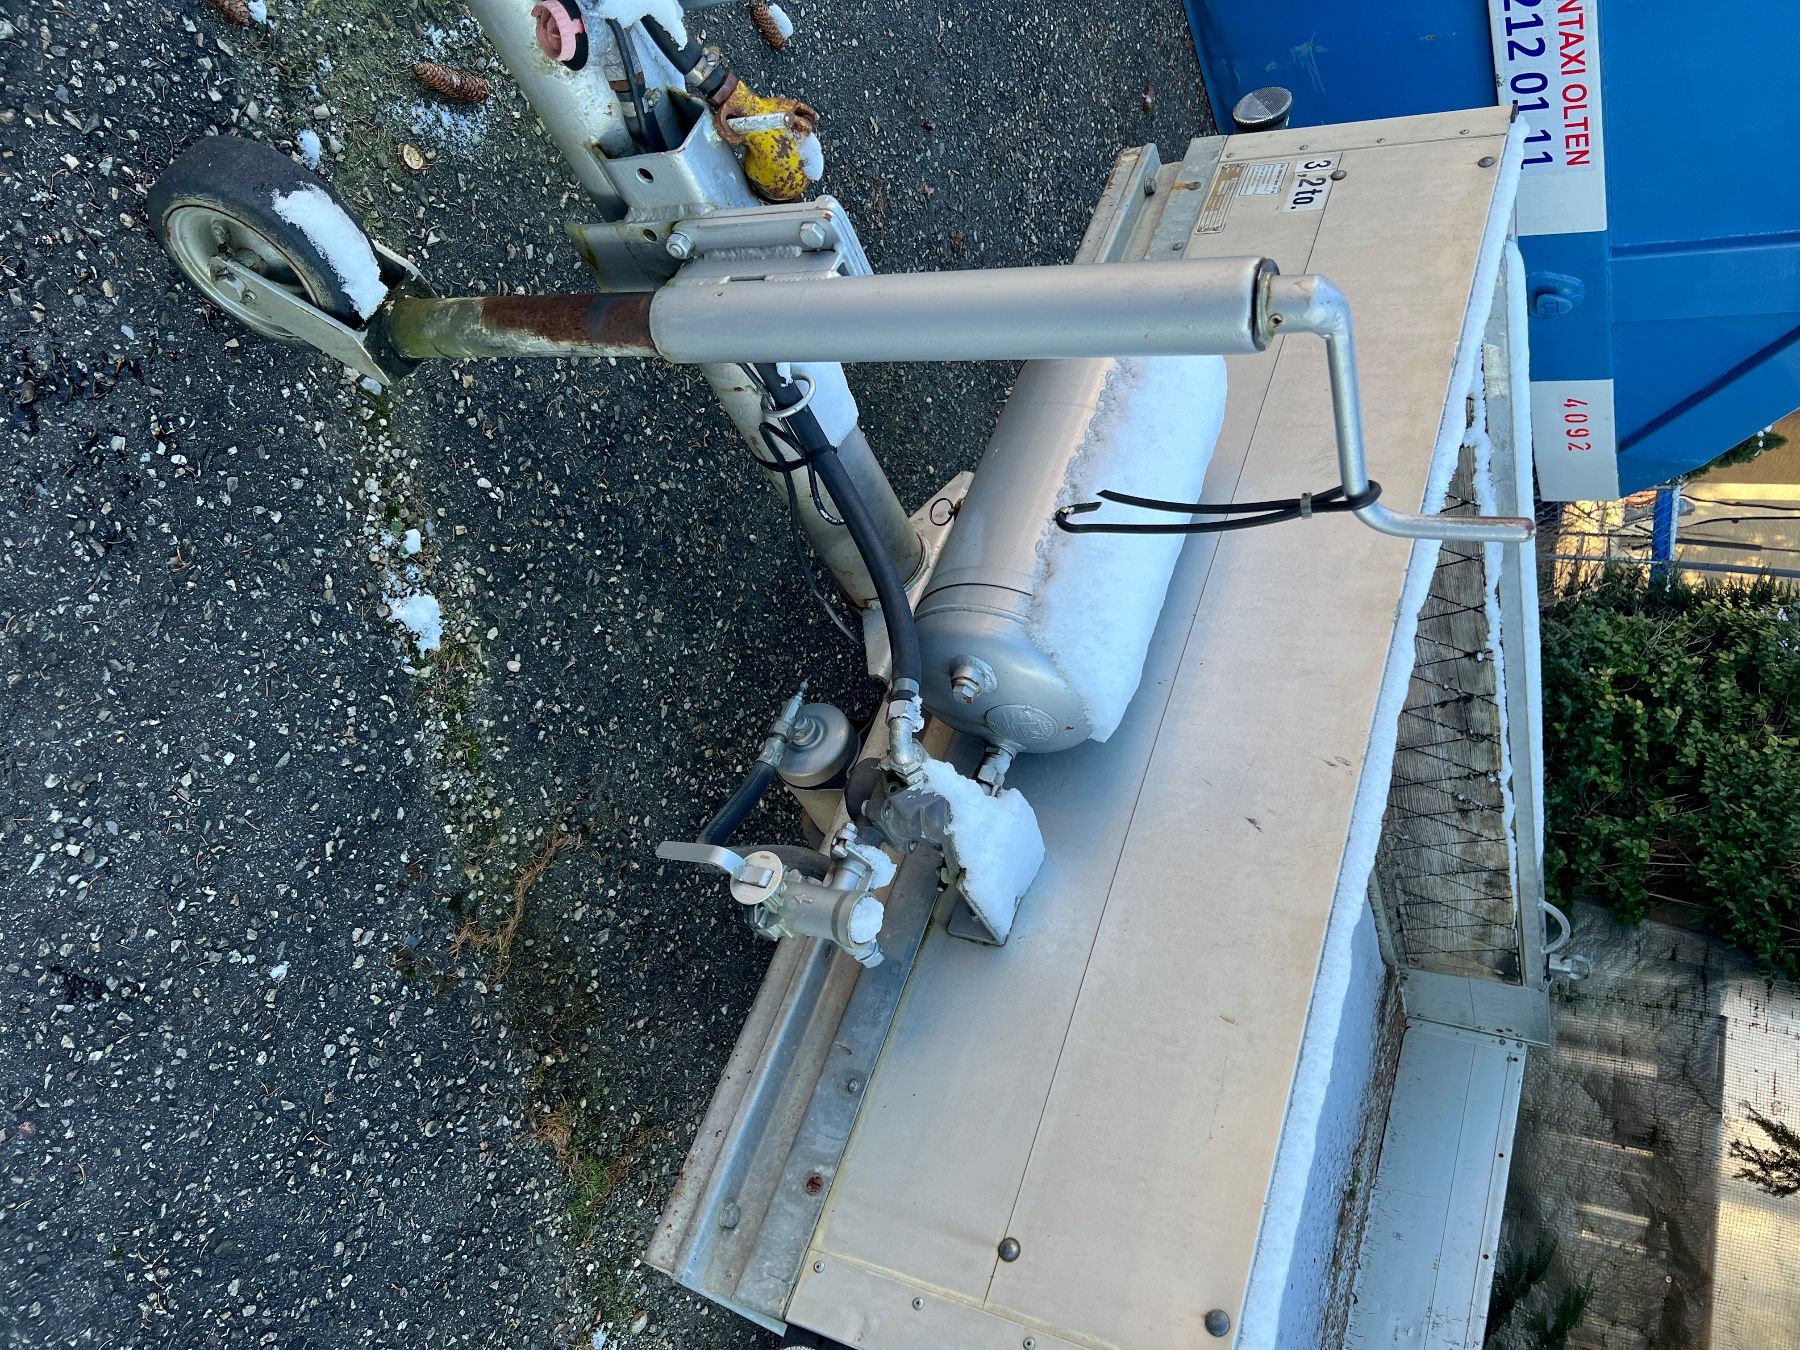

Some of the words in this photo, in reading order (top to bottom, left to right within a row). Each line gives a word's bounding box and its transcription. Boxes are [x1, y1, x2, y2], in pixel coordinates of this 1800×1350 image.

[1510, 72, 1550, 113] 01
[1561, 83, 1590, 166] OLTEN
[1520, 129, 1553, 170] 11
[1563, 398, 1592, 452] 4092
